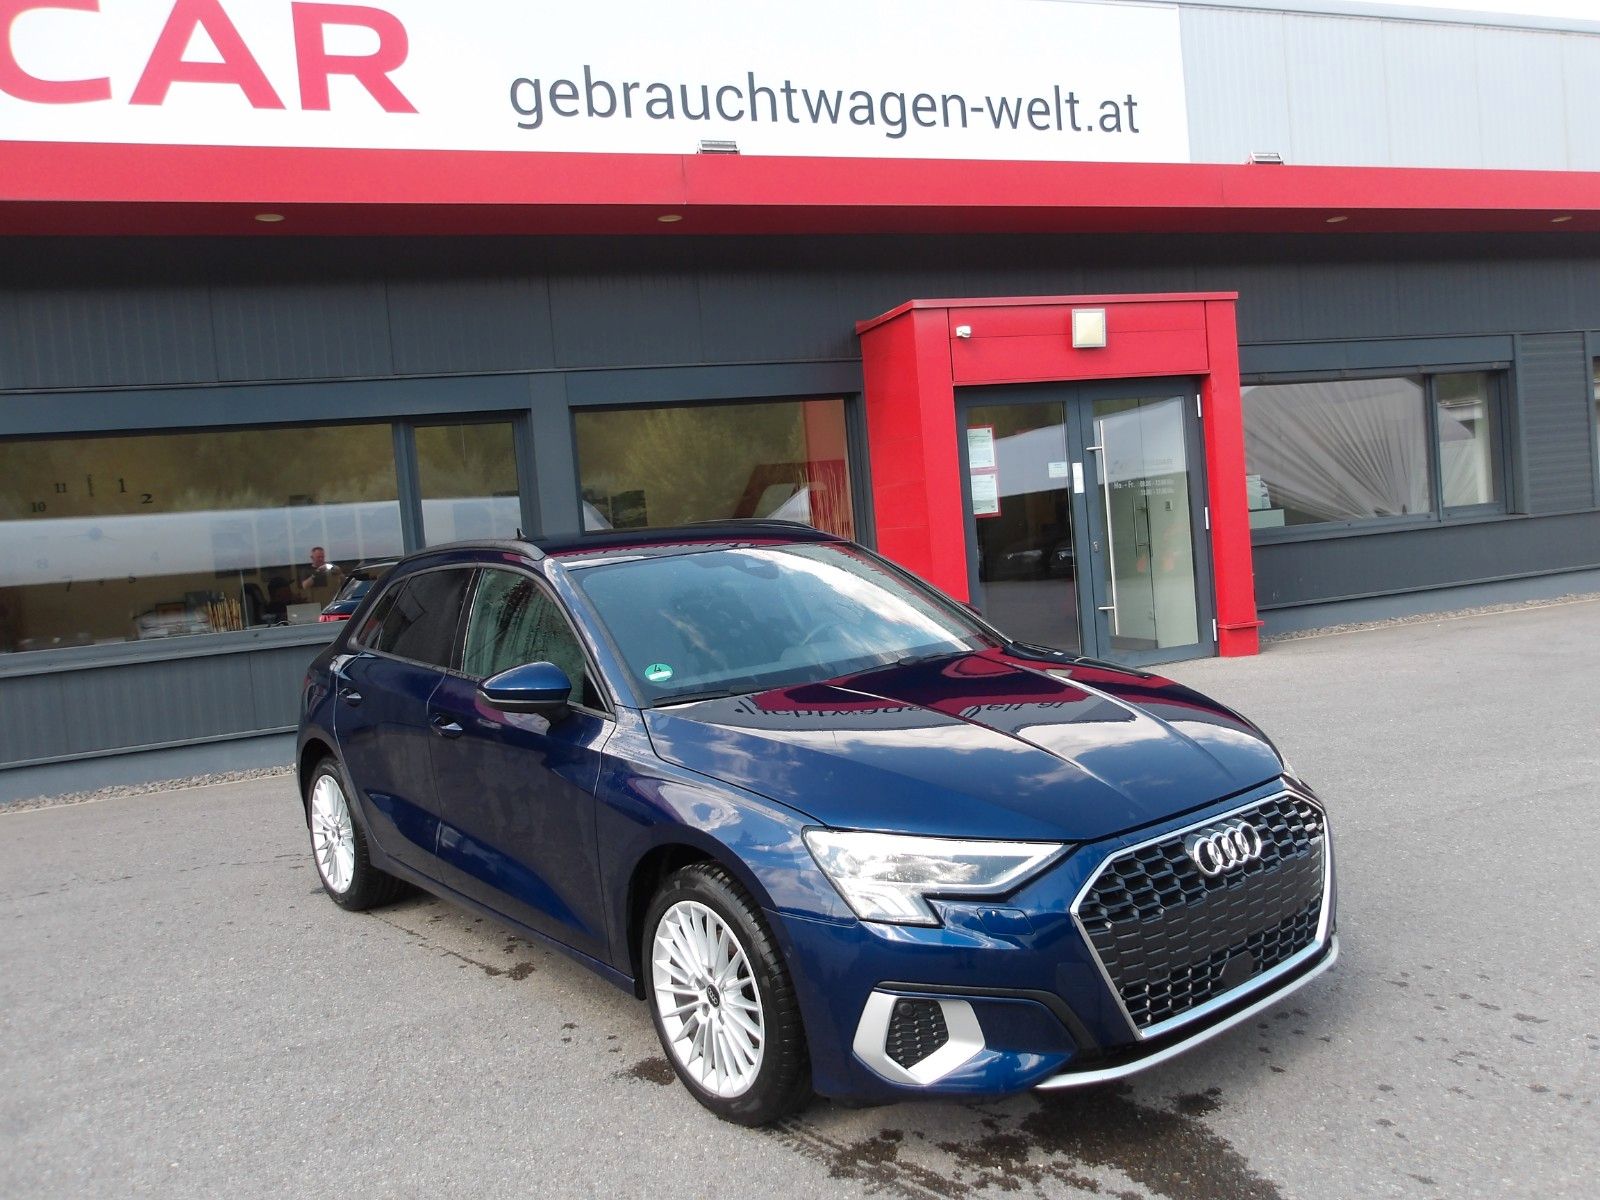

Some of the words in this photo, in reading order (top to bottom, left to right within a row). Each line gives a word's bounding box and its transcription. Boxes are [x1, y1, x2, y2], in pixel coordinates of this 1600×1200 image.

[0, 0, 420, 114] CAR
[510, 64, 1140, 138] gebrauchtwagen-welt.at
[54, 483, 67, 494] 11
[141, 494, 154, 504] 2
[31, 502, 46, 513] 10
[653, 664, 662, 672] 4
